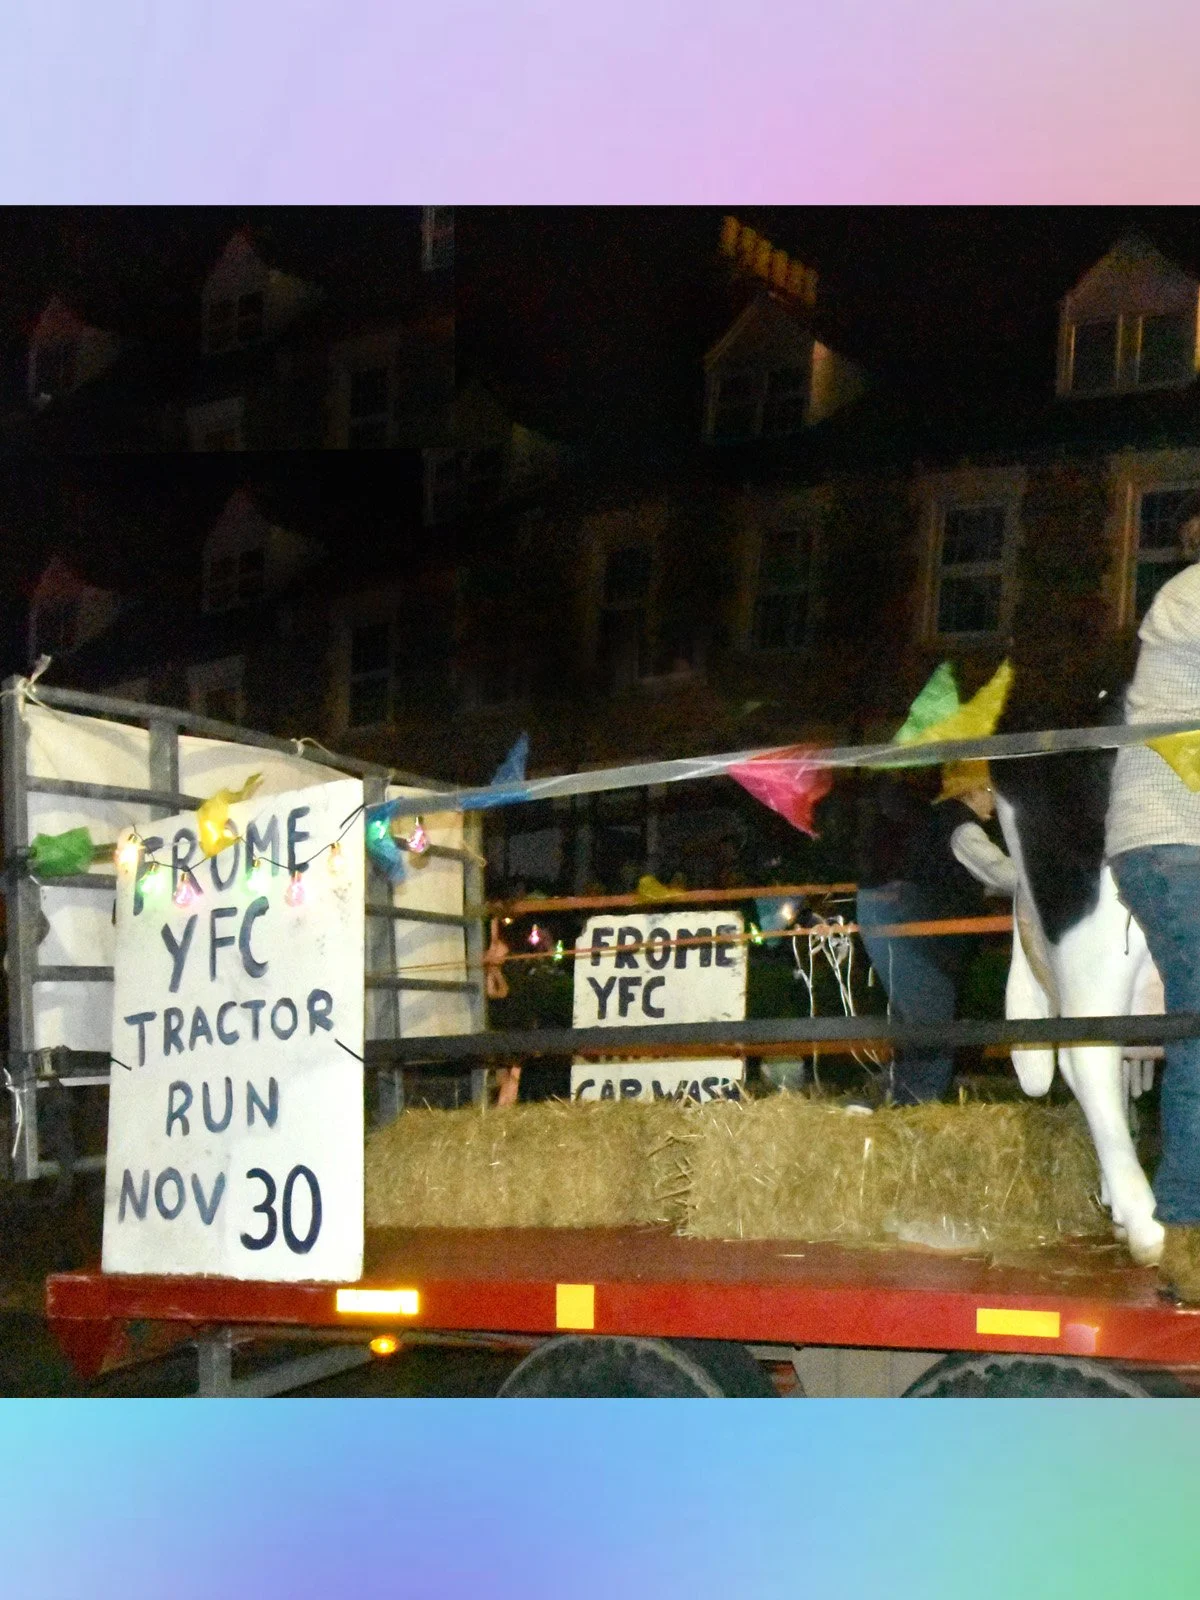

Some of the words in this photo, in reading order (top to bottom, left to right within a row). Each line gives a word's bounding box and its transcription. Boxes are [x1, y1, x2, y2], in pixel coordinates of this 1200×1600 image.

[133, 806, 311, 916] FROME
[161, 896, 270, 993] YFC
[590, 924, 738, 970] FROME
[124, 988, 334, 1067] TRACTOR
[587, 976, 665, 1020] YFC
[166, 1076, 279, 1137] RUN
[118, 1166, 226, 1226] NOV
[240, 1164, 323, 1255] 30
